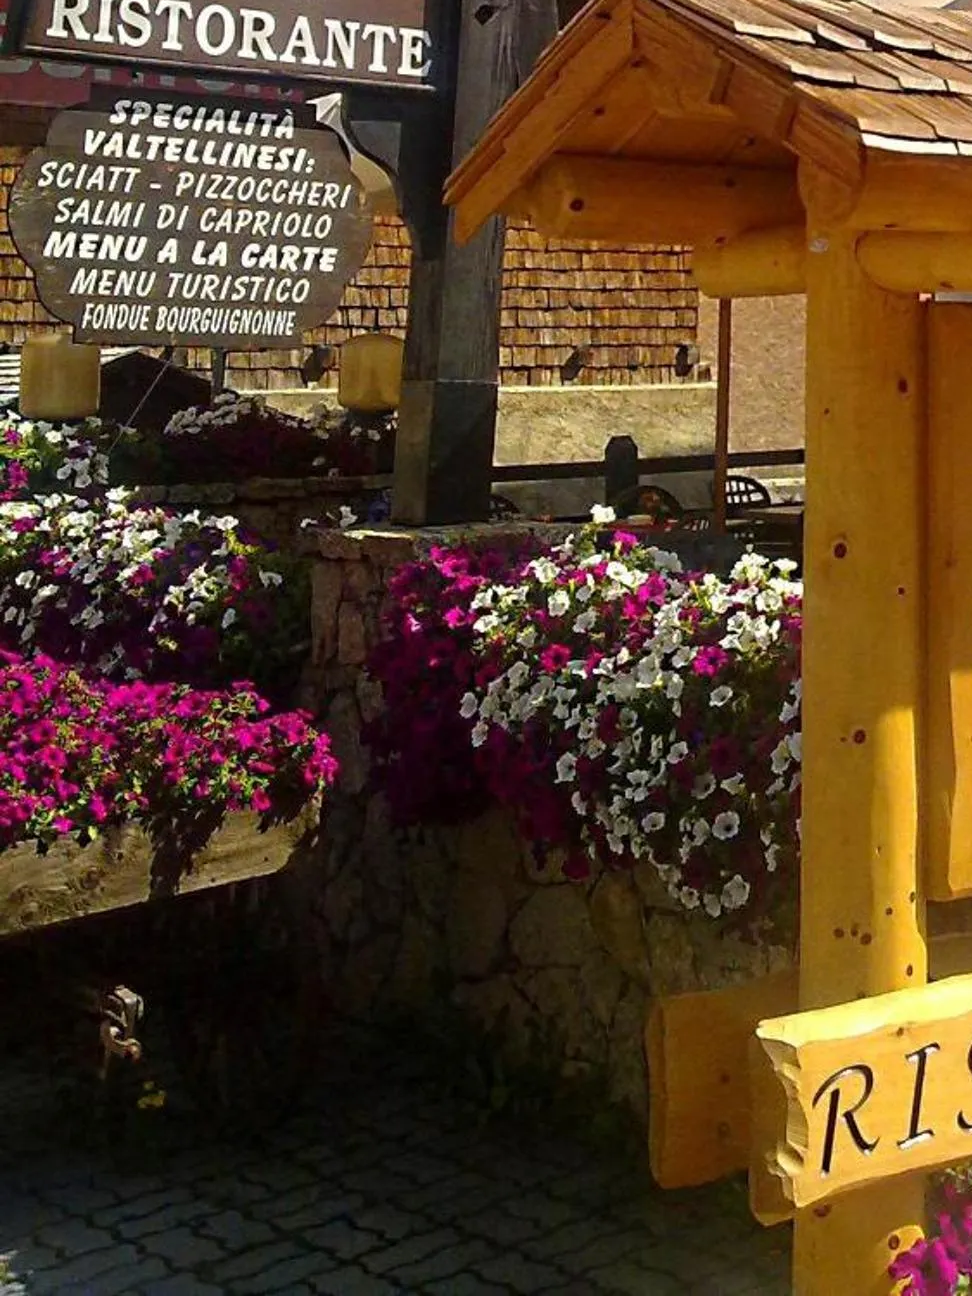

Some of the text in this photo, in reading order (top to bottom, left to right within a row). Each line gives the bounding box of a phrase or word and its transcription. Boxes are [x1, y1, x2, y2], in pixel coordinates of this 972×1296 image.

[109, 100, 295, 139] SPECIALITÀ
[84, 129, 315, 174] VALTELLINESI:
[38, 161, 141, 192] SCIATT
[175, 171, 352, 209] PIZZOCCHERI
[54, 198, 333, 240] SALMI DI CAPRIOLO
[43, 231, 339, 273] MENU A LA CARTE
[69, 268, 311, 304] MENU TURISTICO
[81, 302, 297, 337] FONDUE BOURGUIGNONNE
